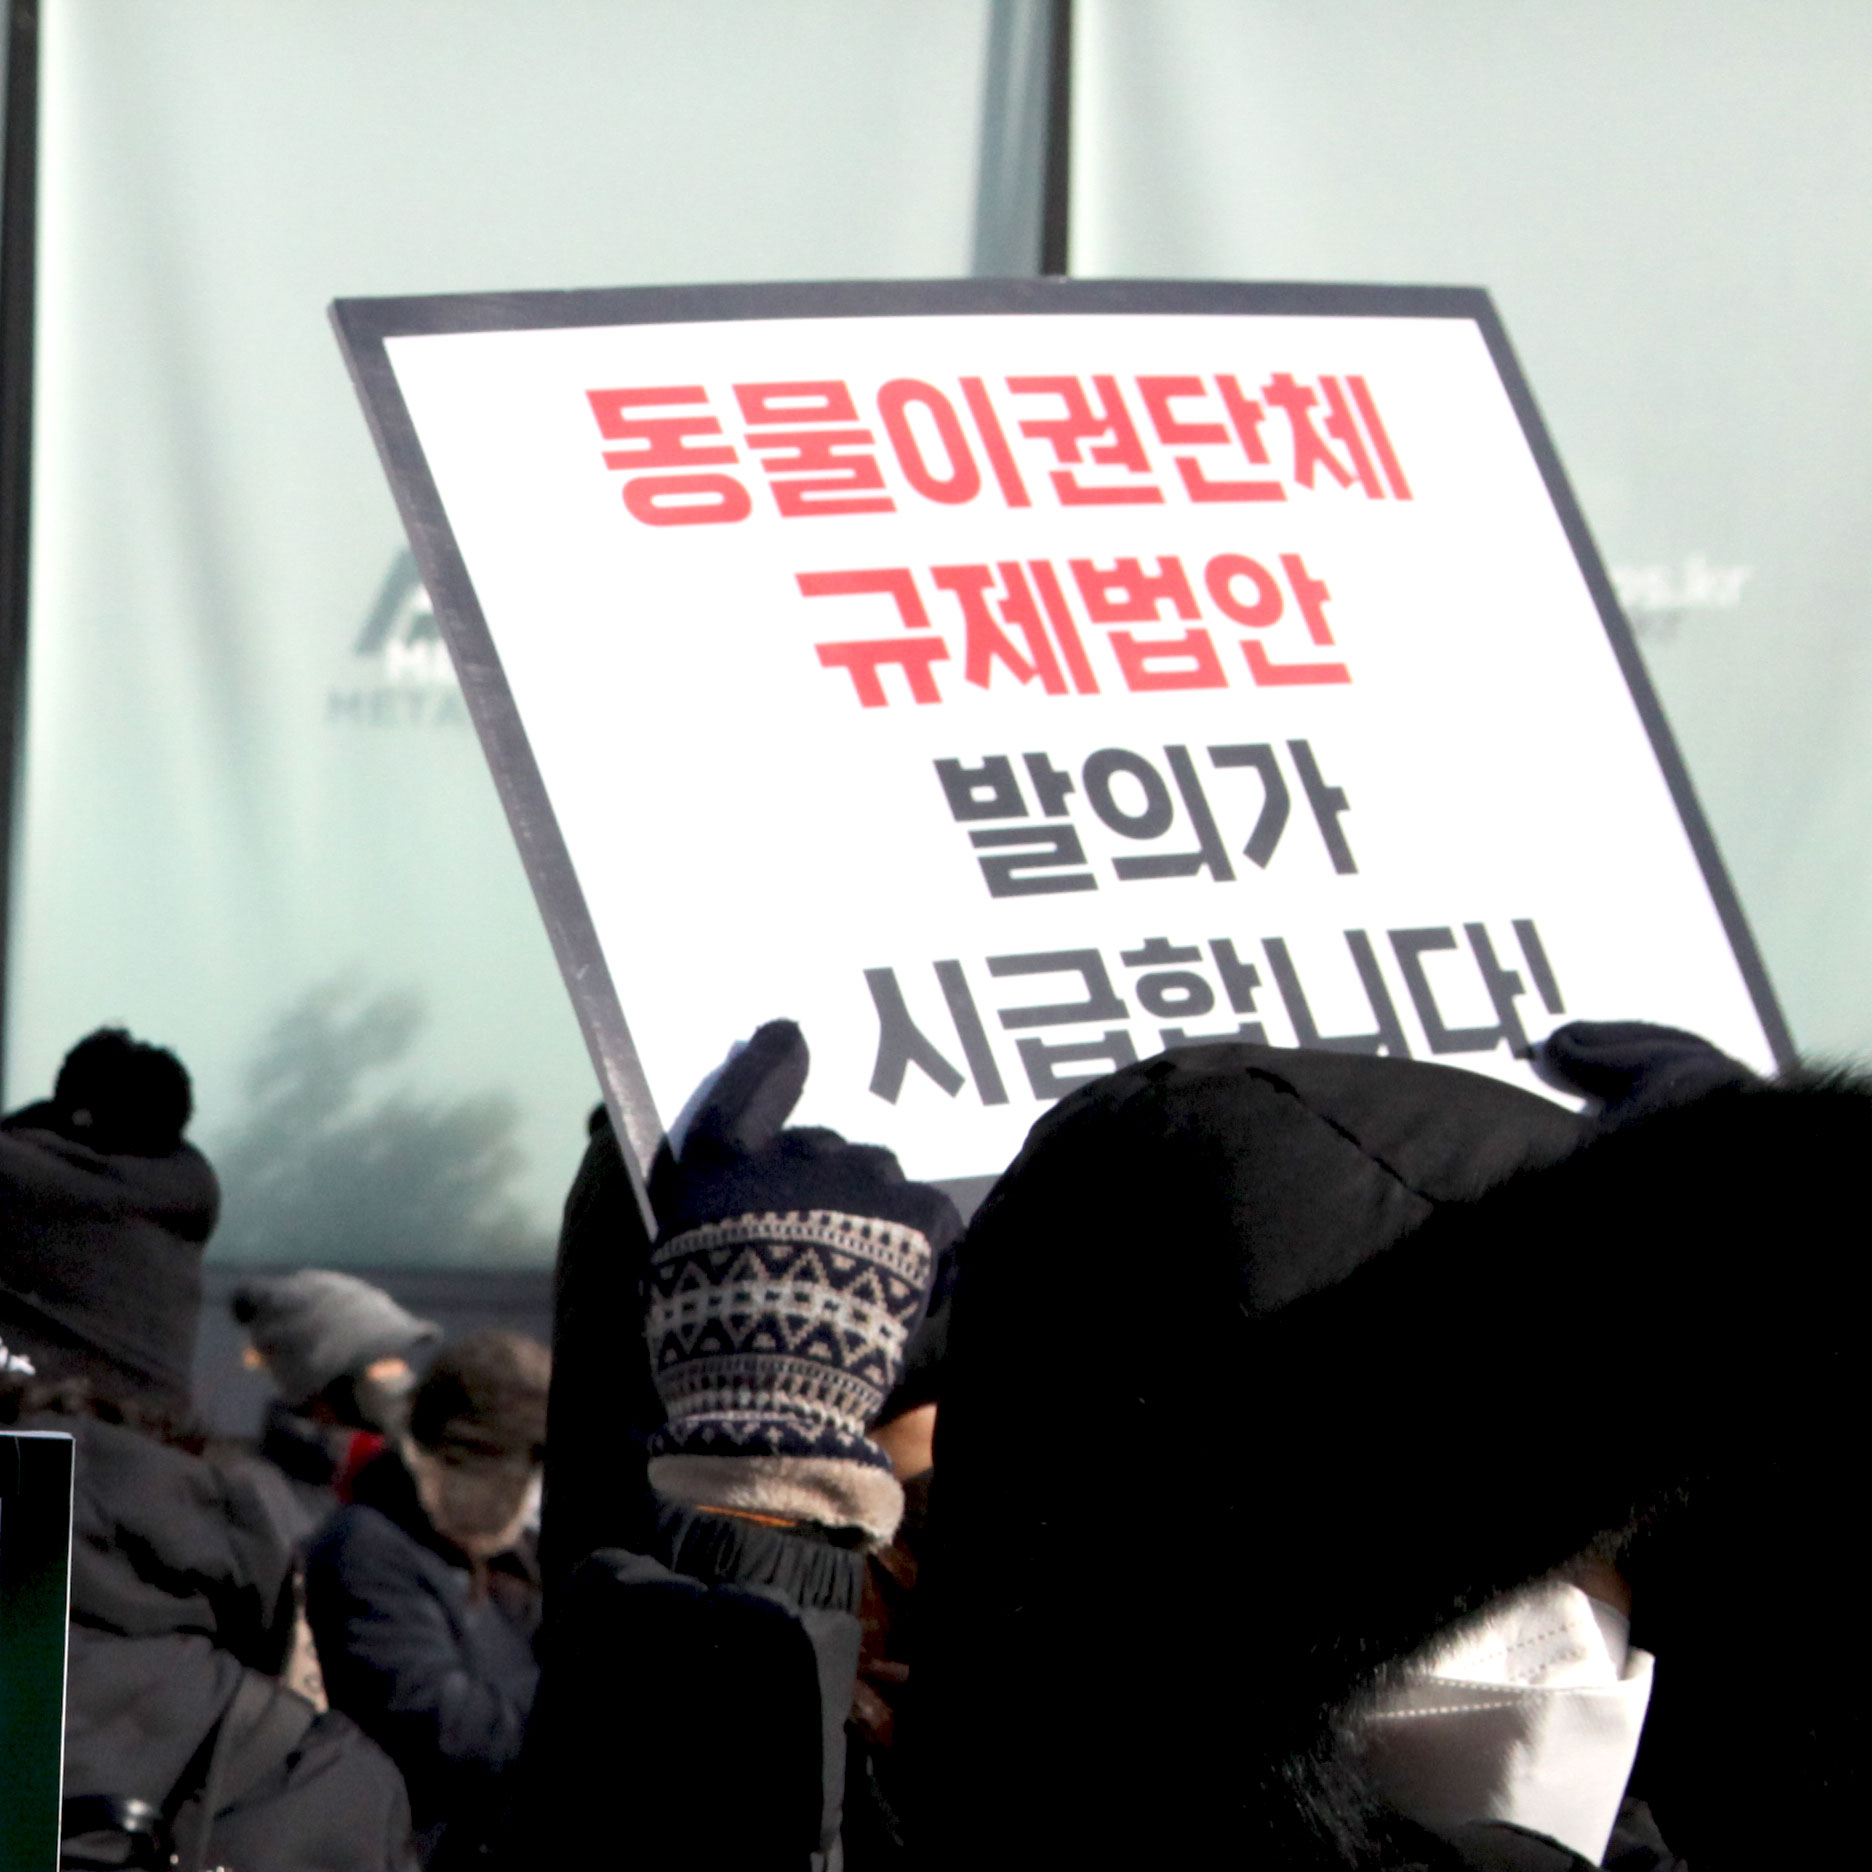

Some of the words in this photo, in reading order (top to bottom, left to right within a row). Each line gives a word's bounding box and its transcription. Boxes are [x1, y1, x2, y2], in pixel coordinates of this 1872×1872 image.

[585, 372, 1413, 527] 동물이권단체
[794, 553, 1352, 709] 규제법안
[934, 739, 1359, 898] 발의가
[863, 919, 1565, 1106] 시급합니다!
